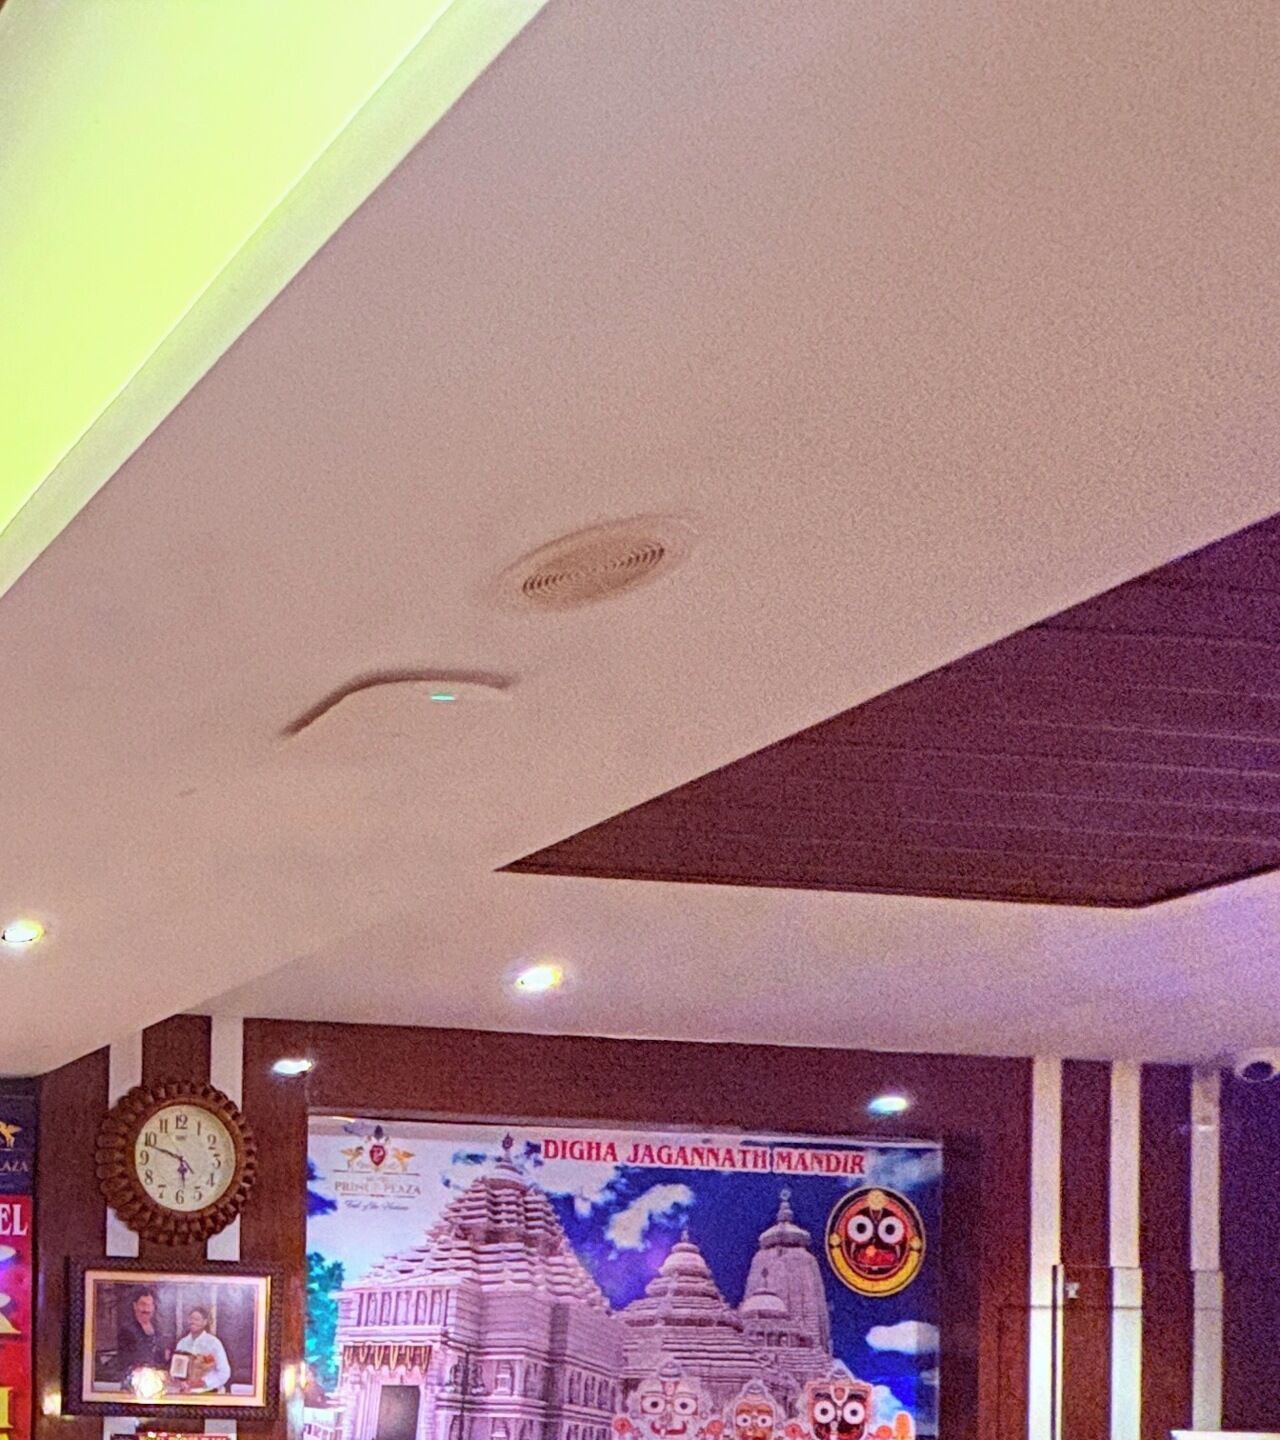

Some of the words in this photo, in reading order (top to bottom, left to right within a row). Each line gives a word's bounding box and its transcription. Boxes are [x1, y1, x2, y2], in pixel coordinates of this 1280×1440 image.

[159, 1118, 168, 1134] 11
[175, 1114, 188, 1130] 12
[207, 1134, 217, 1150] 2
[139, 1150, 150, 1166] 9
[542, 1138, 618, 1162] DIGHA
[626, 1143, 768, 1169] JAGANNATH
[774, 1149, 865, 1174] MANDIR
[144, 1169, 153, 1185] 8
[206, 1172, 215, 1188] 4
[157, 1184, 167, 1199] 7
[175, 1189, 185, 1205] 6
